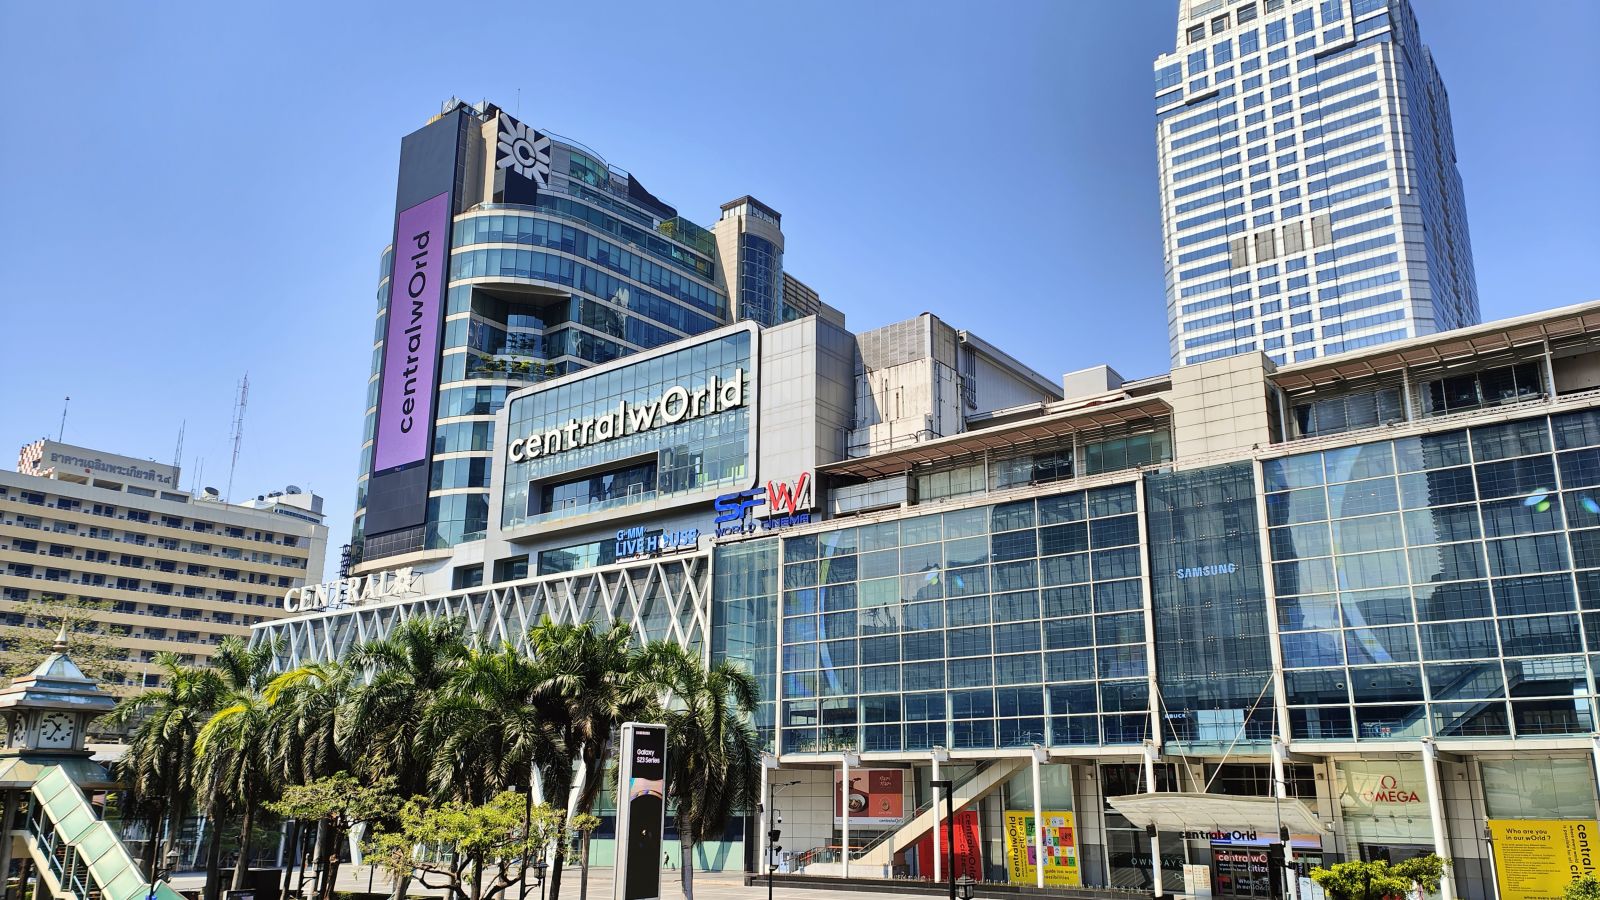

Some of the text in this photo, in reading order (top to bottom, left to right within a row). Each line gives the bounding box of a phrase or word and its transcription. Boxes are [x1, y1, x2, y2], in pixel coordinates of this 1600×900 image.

[400, 230, 430, 434] centralwOrld
[508, 368, 743, 463] centralwOrld
[715, 487, 766, 523] SF
[715, 513, 810, 537] WORLD CINEMA
[616, 537, 644, 557] LIVE
[1177, 563, 1236, 579] SAMSUNG
[284, 570, 394, 613] CENTRAL
[636, 749, 655, 757] Galaxy
[1009, 817, 1020, 877] centralwOrld
[1179, 830, 1257, 840] centralwOrld
[1131, 857, 1184, 868] OWNAYS
